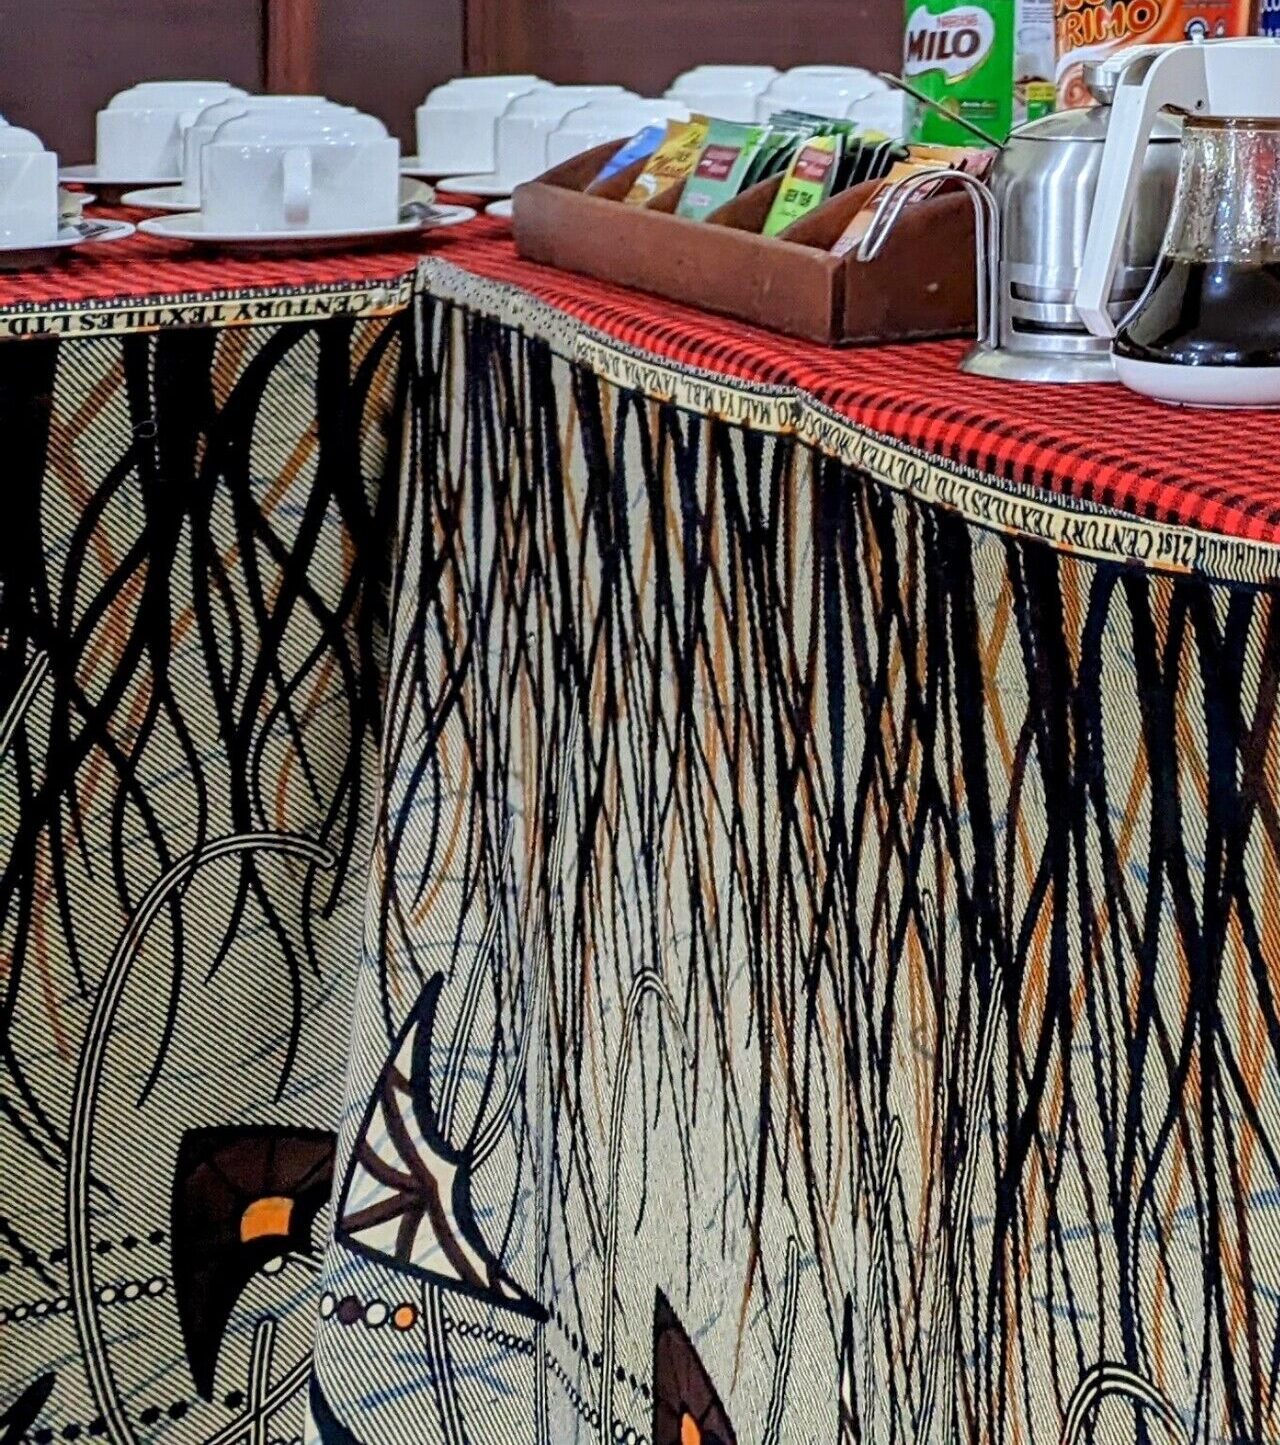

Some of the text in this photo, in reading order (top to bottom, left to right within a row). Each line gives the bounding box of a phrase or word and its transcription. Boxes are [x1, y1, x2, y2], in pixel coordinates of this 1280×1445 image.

[907, 28, 981, 62] MILO
[80, 303, 225, 333] TEXTILES
[225, 293, 368, 322] CENTURY
[738, 395, 772, 426] MALI
[934, 474, 970, 512] LTD.
[971, 489, 1057, 540] TEXTILES
[1061, 515, 1152, 559] CENTURY
[1156, 530, 1193, 566] 21st
